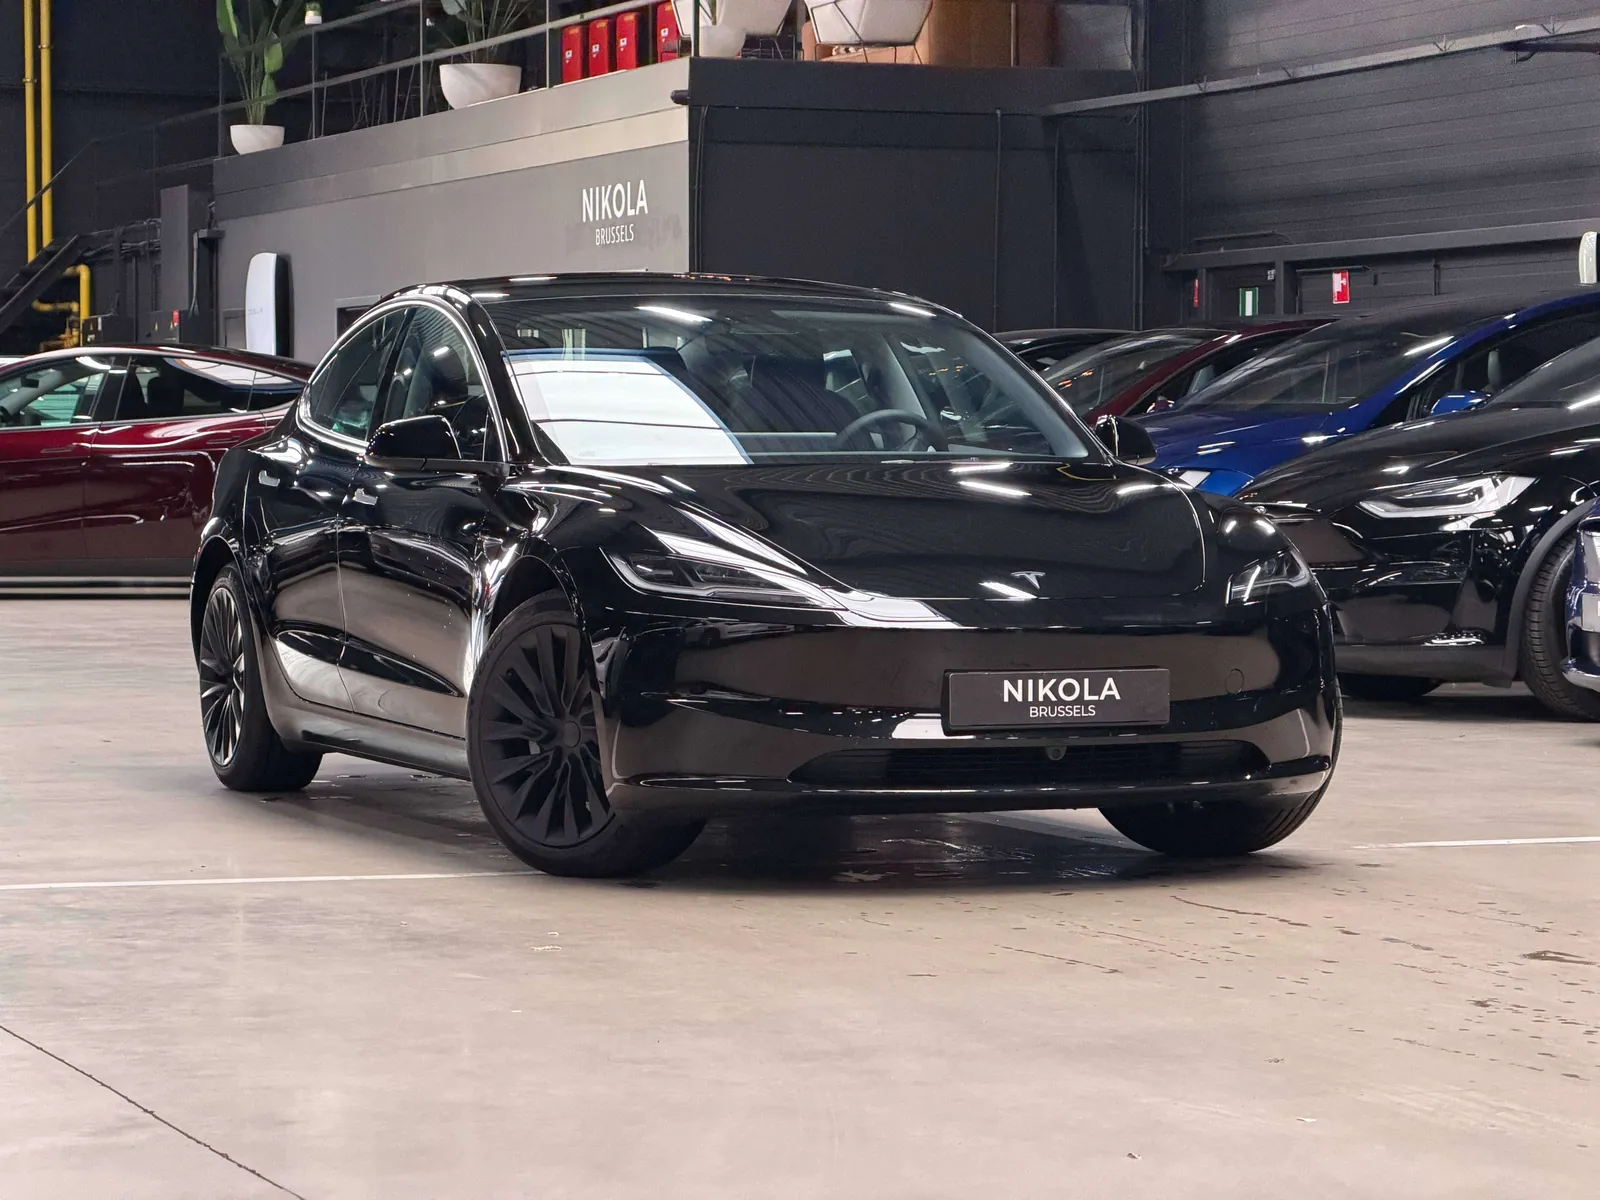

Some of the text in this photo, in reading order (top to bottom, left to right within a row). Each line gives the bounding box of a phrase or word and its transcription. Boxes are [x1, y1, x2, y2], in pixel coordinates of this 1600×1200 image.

[582, 179, 648, 223] NIKOLA
[595, 223, 635, 246] BRUSSELS
[1003, 677, 1121, 702] NIKOLA
[1029, 704, 1096, 718] BRUSSELS
